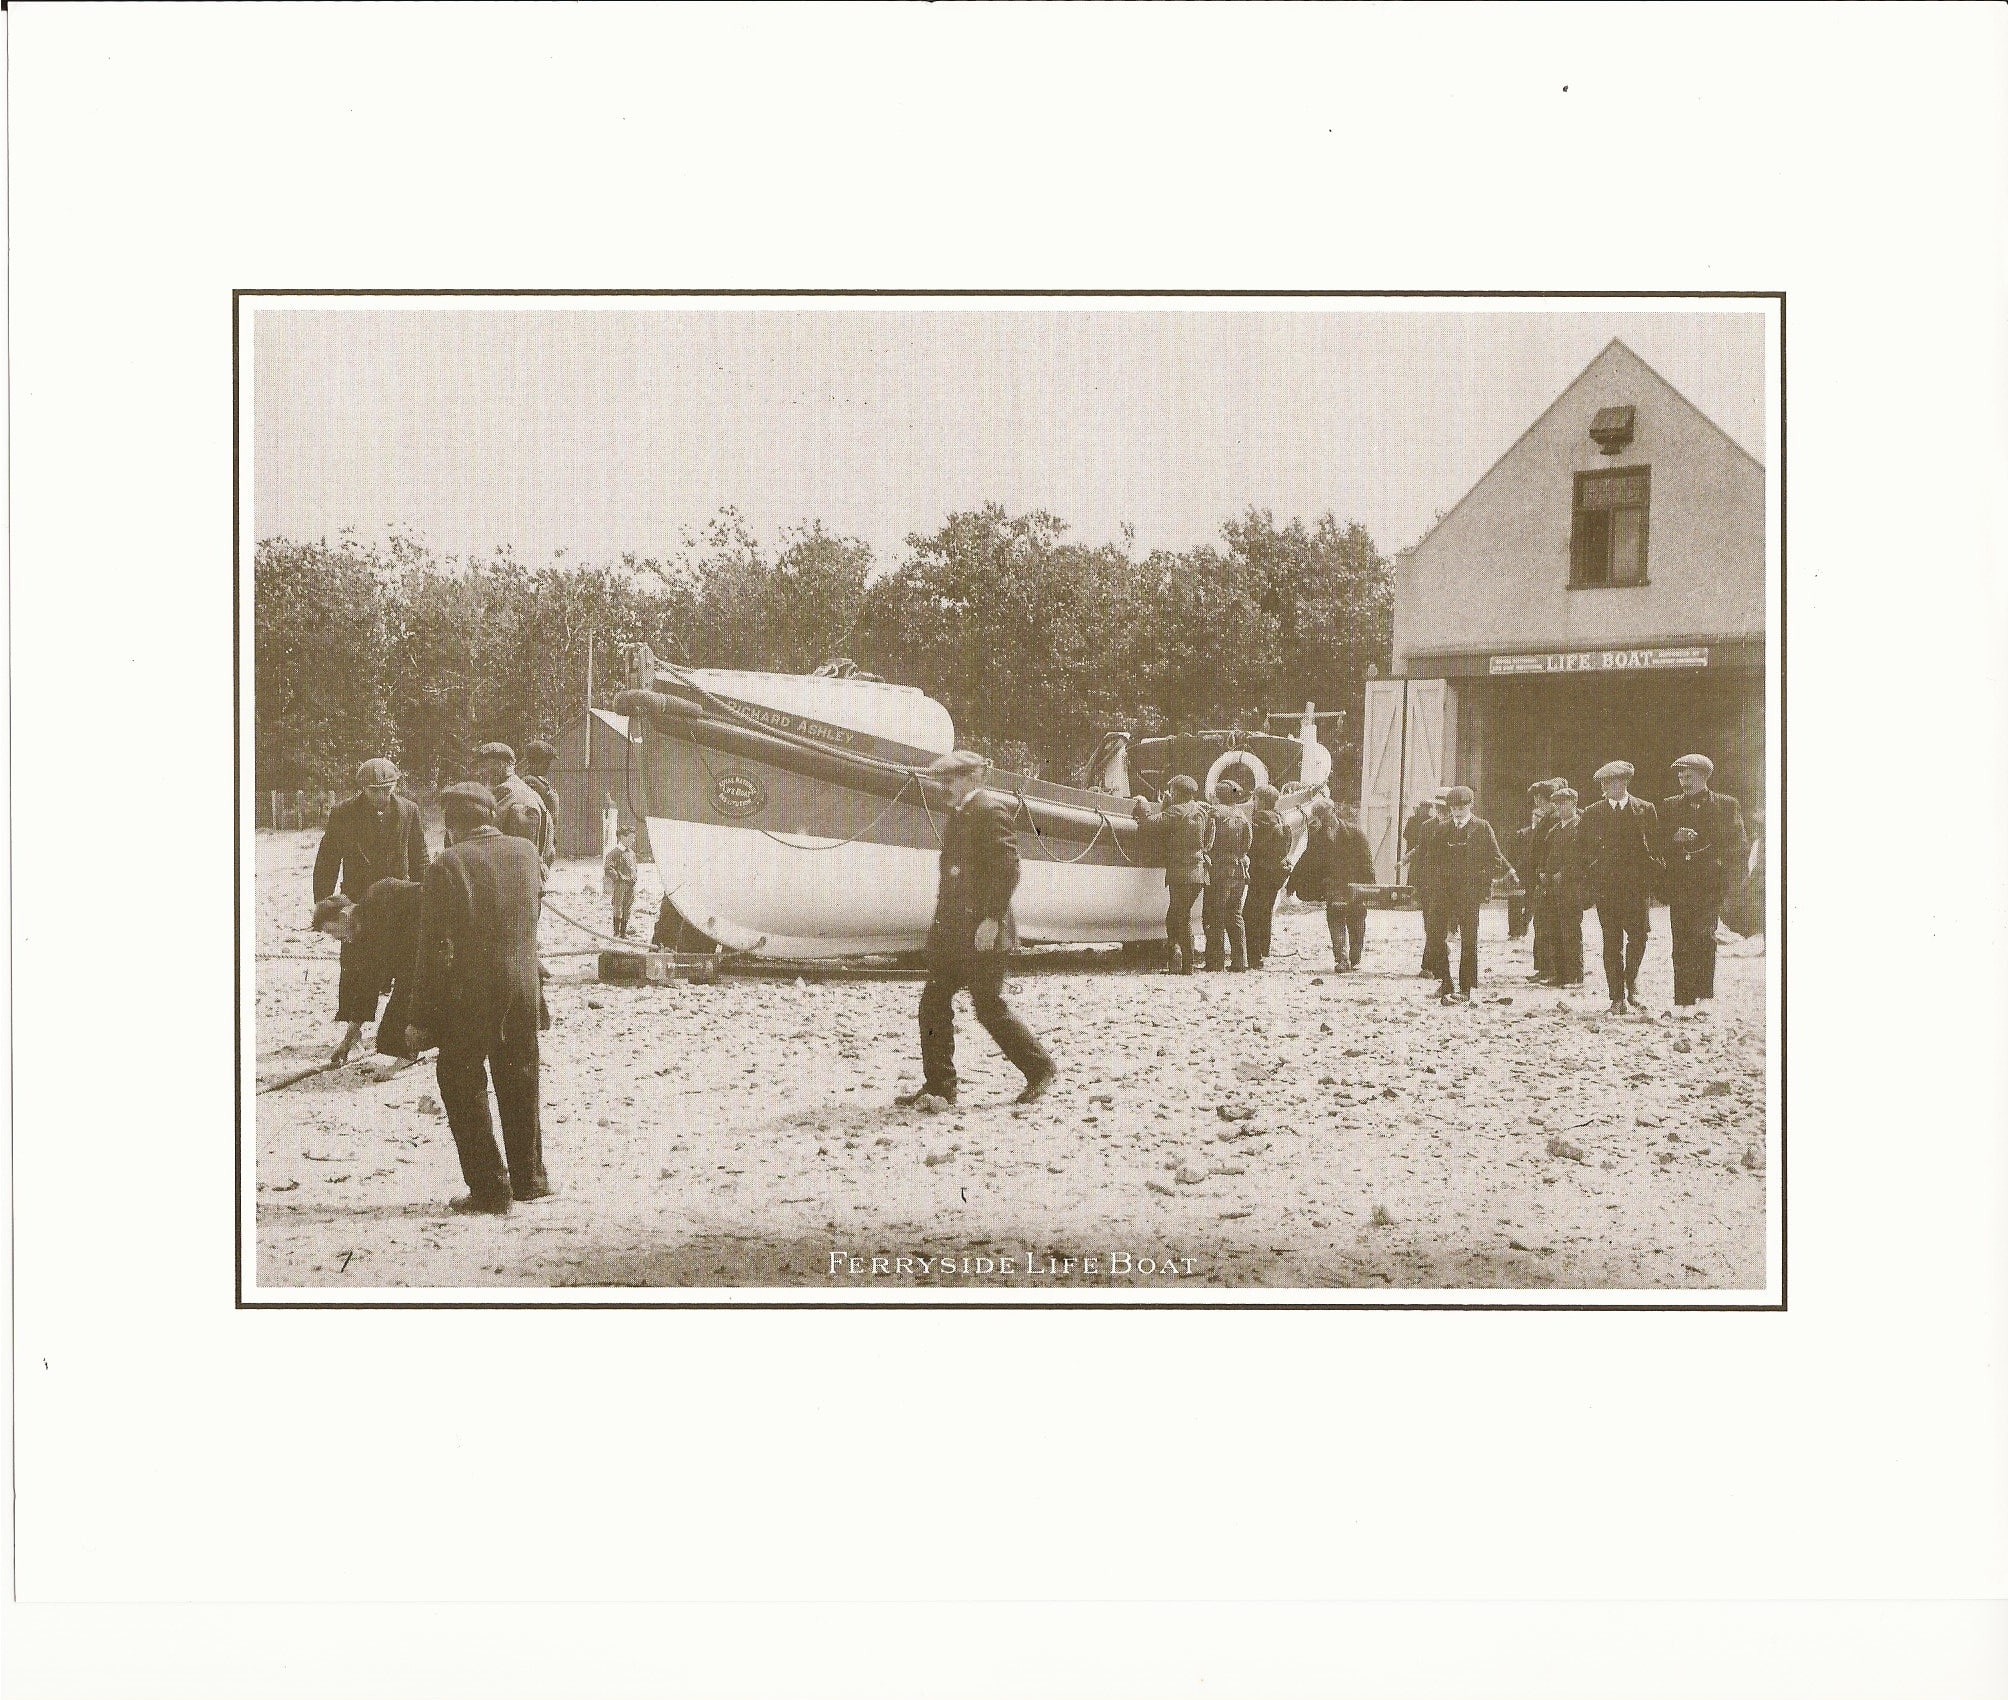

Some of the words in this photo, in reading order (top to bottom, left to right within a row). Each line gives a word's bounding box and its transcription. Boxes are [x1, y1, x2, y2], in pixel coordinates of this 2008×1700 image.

[1545, 654, 1590, 672] LIFE
[1602, 650, 1653, 669] BOAT
[727, 701, 791, 727] RICHARD
[797, 720, 855, 744] ASHLEY
